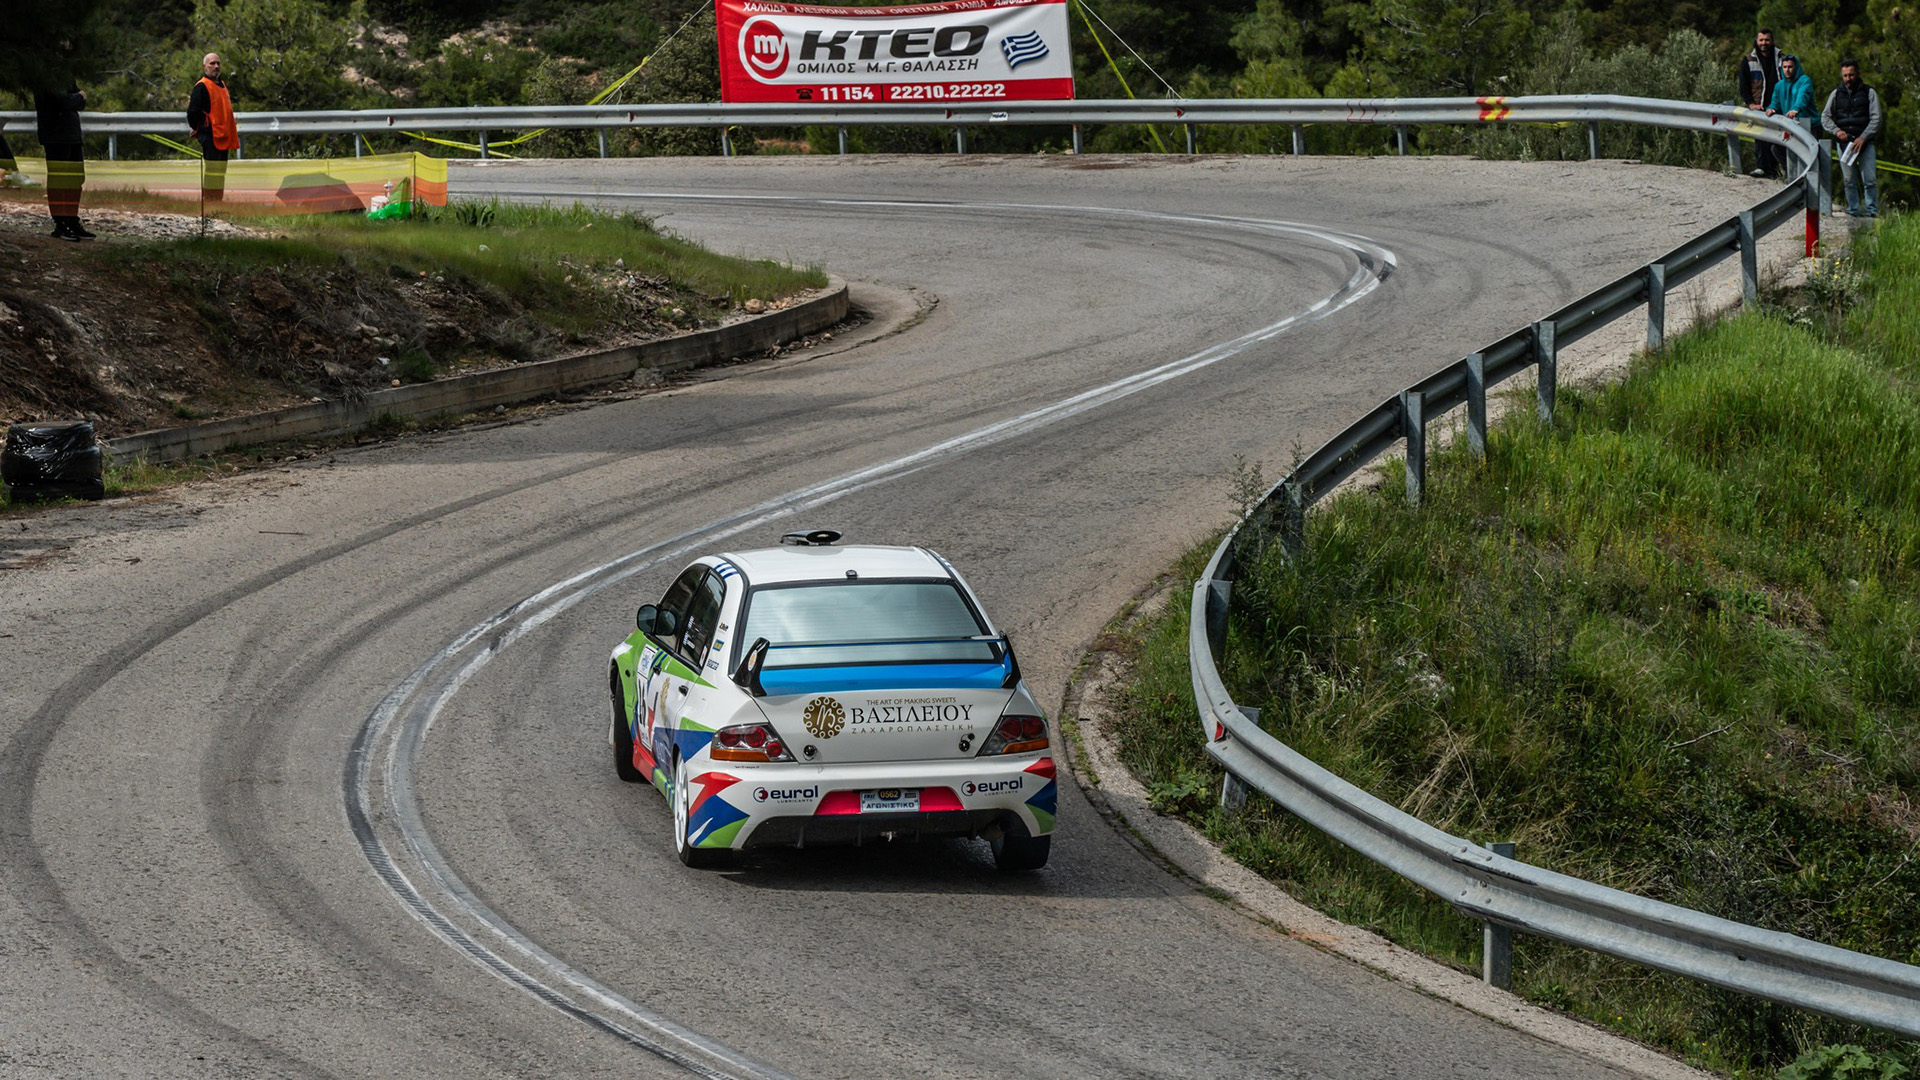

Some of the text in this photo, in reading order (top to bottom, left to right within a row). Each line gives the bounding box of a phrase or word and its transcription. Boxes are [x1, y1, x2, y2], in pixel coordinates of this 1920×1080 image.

[742, 2, 788, 13] ΧΑΛΚΙΔΑ
[955, 0, 987, 10] ΛΑΜΙΑ
[799, 25, 989, 61] ΚΤΕΟ
[797, 58, 980, 74] ΟΜΙΛΟΣ Μ. Γ. ΘΑΛΑΣΣΗ
[842, 87, 874, 100] 154
[890, 83, 1006, 100] 22210.22222
[904, 697, 931, 705] MAKING
[932, 696, 957, 704] SWEETS
[850, 704, 974, 725] ΒΑΣΙΛΕΙΟΥ
[852, 724, 974, 735] ΖΑΧΑΡΟΠΛΑΣΤΙΚΗ
[977, 775, 1023, 793] eurol
[770, 785, 819, 800] eurol
[879, 790, 899, 799] 0562
[866, 801, 915, 810] ΑΓΩΝΙΣΤΙΚΟ
